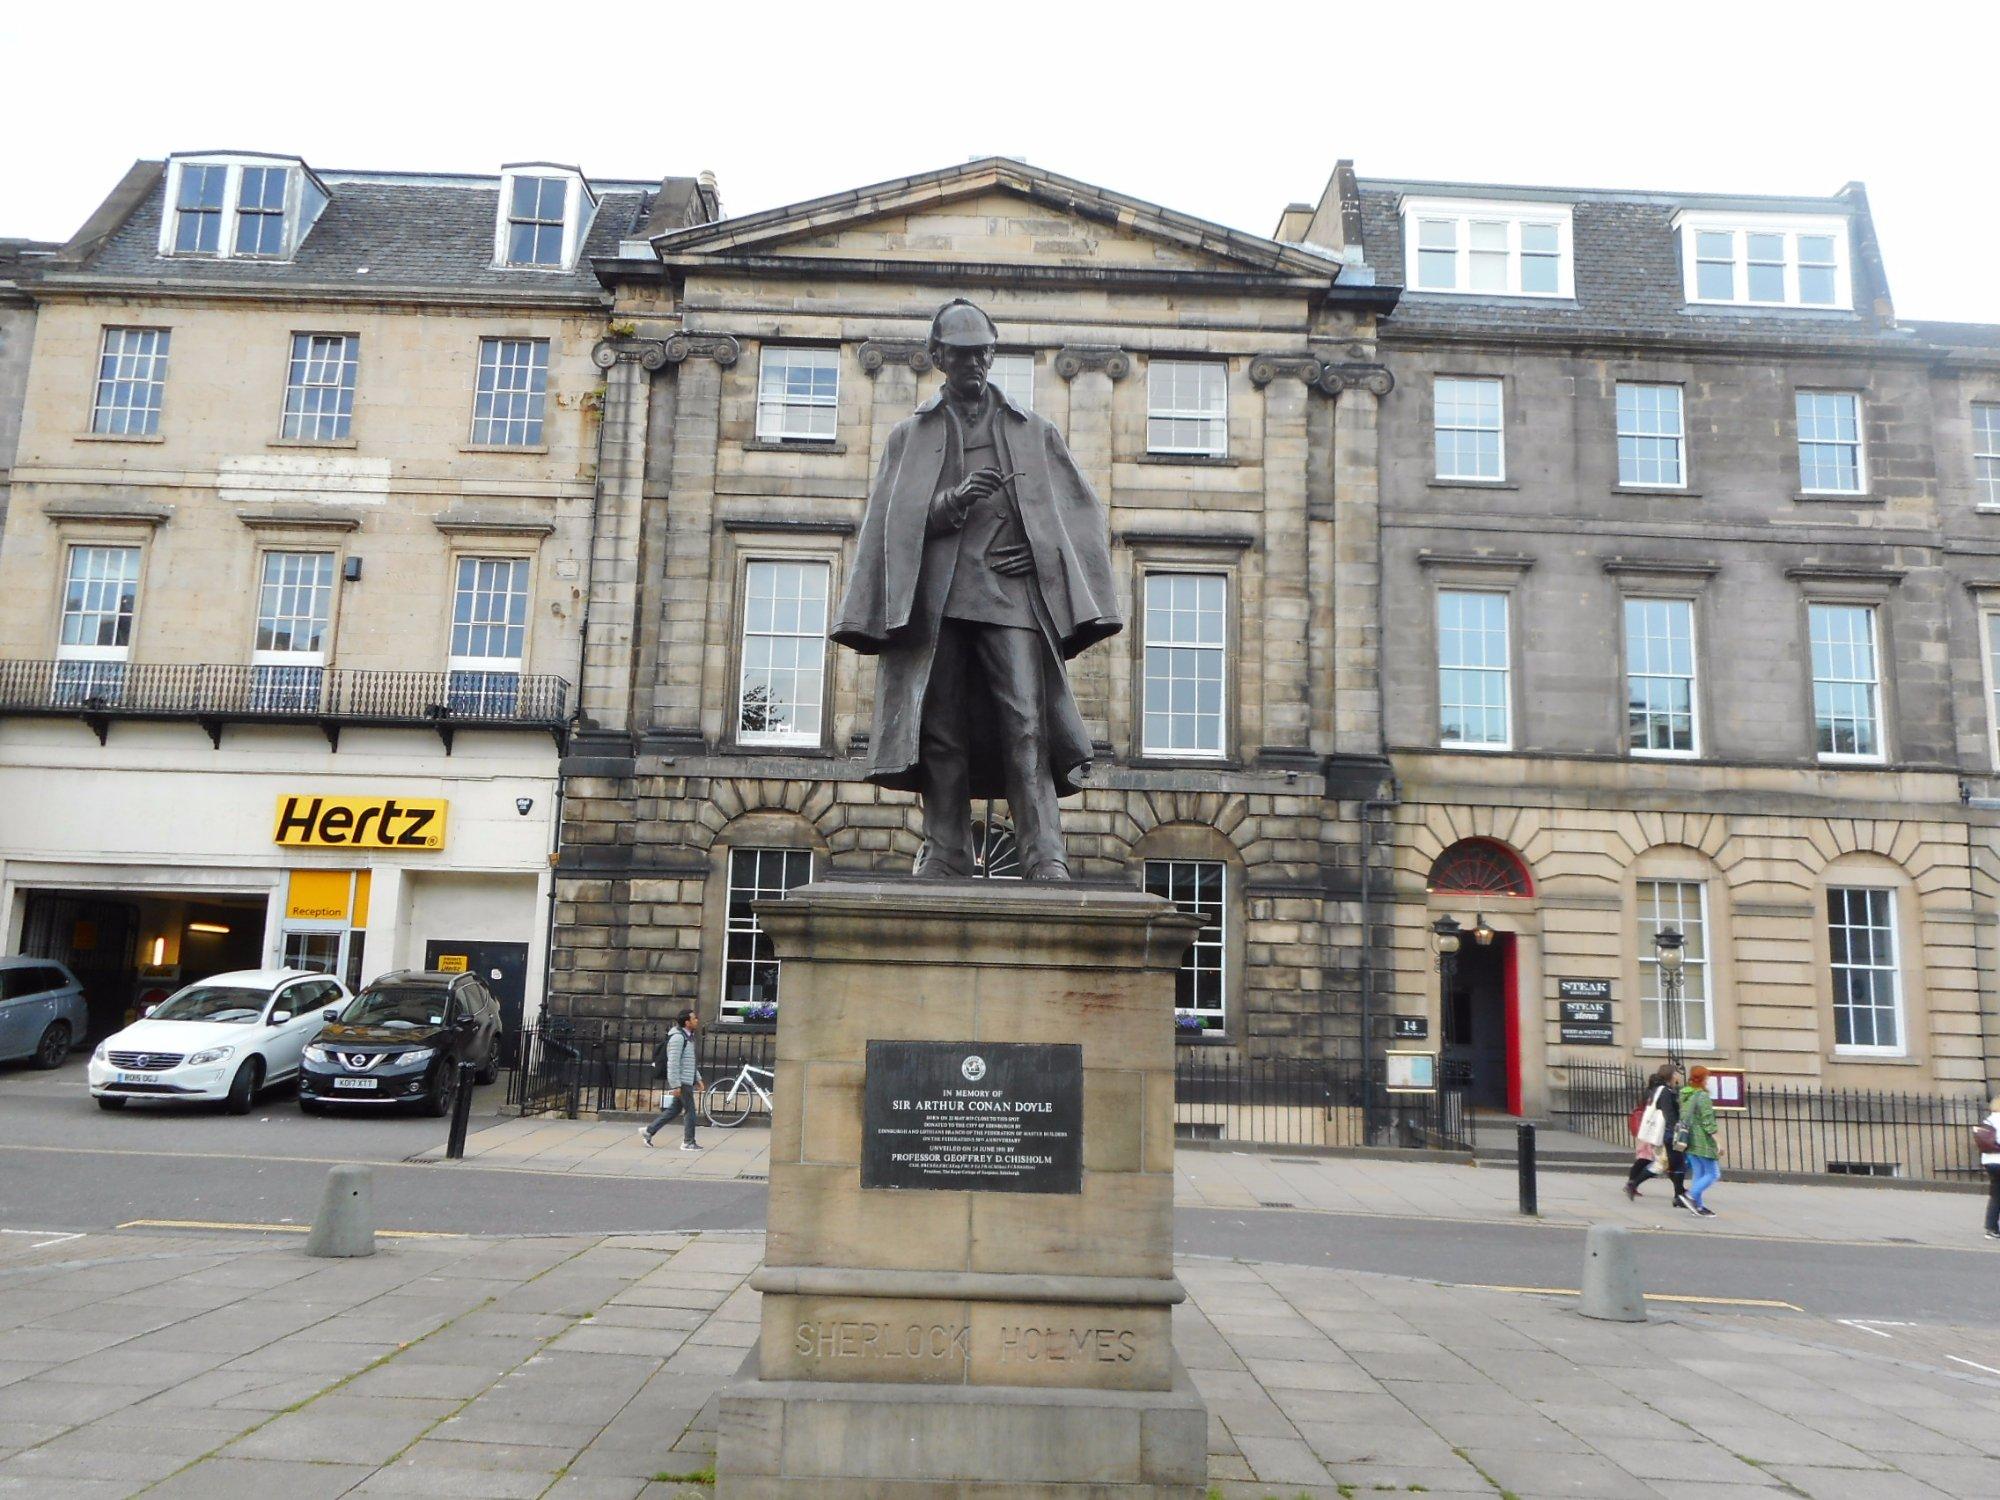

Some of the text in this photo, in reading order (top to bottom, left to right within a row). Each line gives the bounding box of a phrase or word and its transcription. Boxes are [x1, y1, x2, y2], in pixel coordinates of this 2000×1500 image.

[275, 798, 436, 845] Hertz
[293, 906, 342, 918] Reception
[1561, 981, 1607, 992] STEAK
[1566, 1003, 1604, 1011] STEAK
[1402, 1020, 1418, 1031] 14
[943, 1089, 1004, 1098] IN MEMORY OF
[892, 1100, 1053, 1113] SIR ARTHUR CONAN DOYLE
[891, 1153, 941, 1162] PROFESSOR
[943, 1154, 993, 1163] GEOFFREY
[1004, 1155, 1052, 1164] CHISHOLM
[795, 1321, 1136, 1363] SHERLOCK HOLMES
